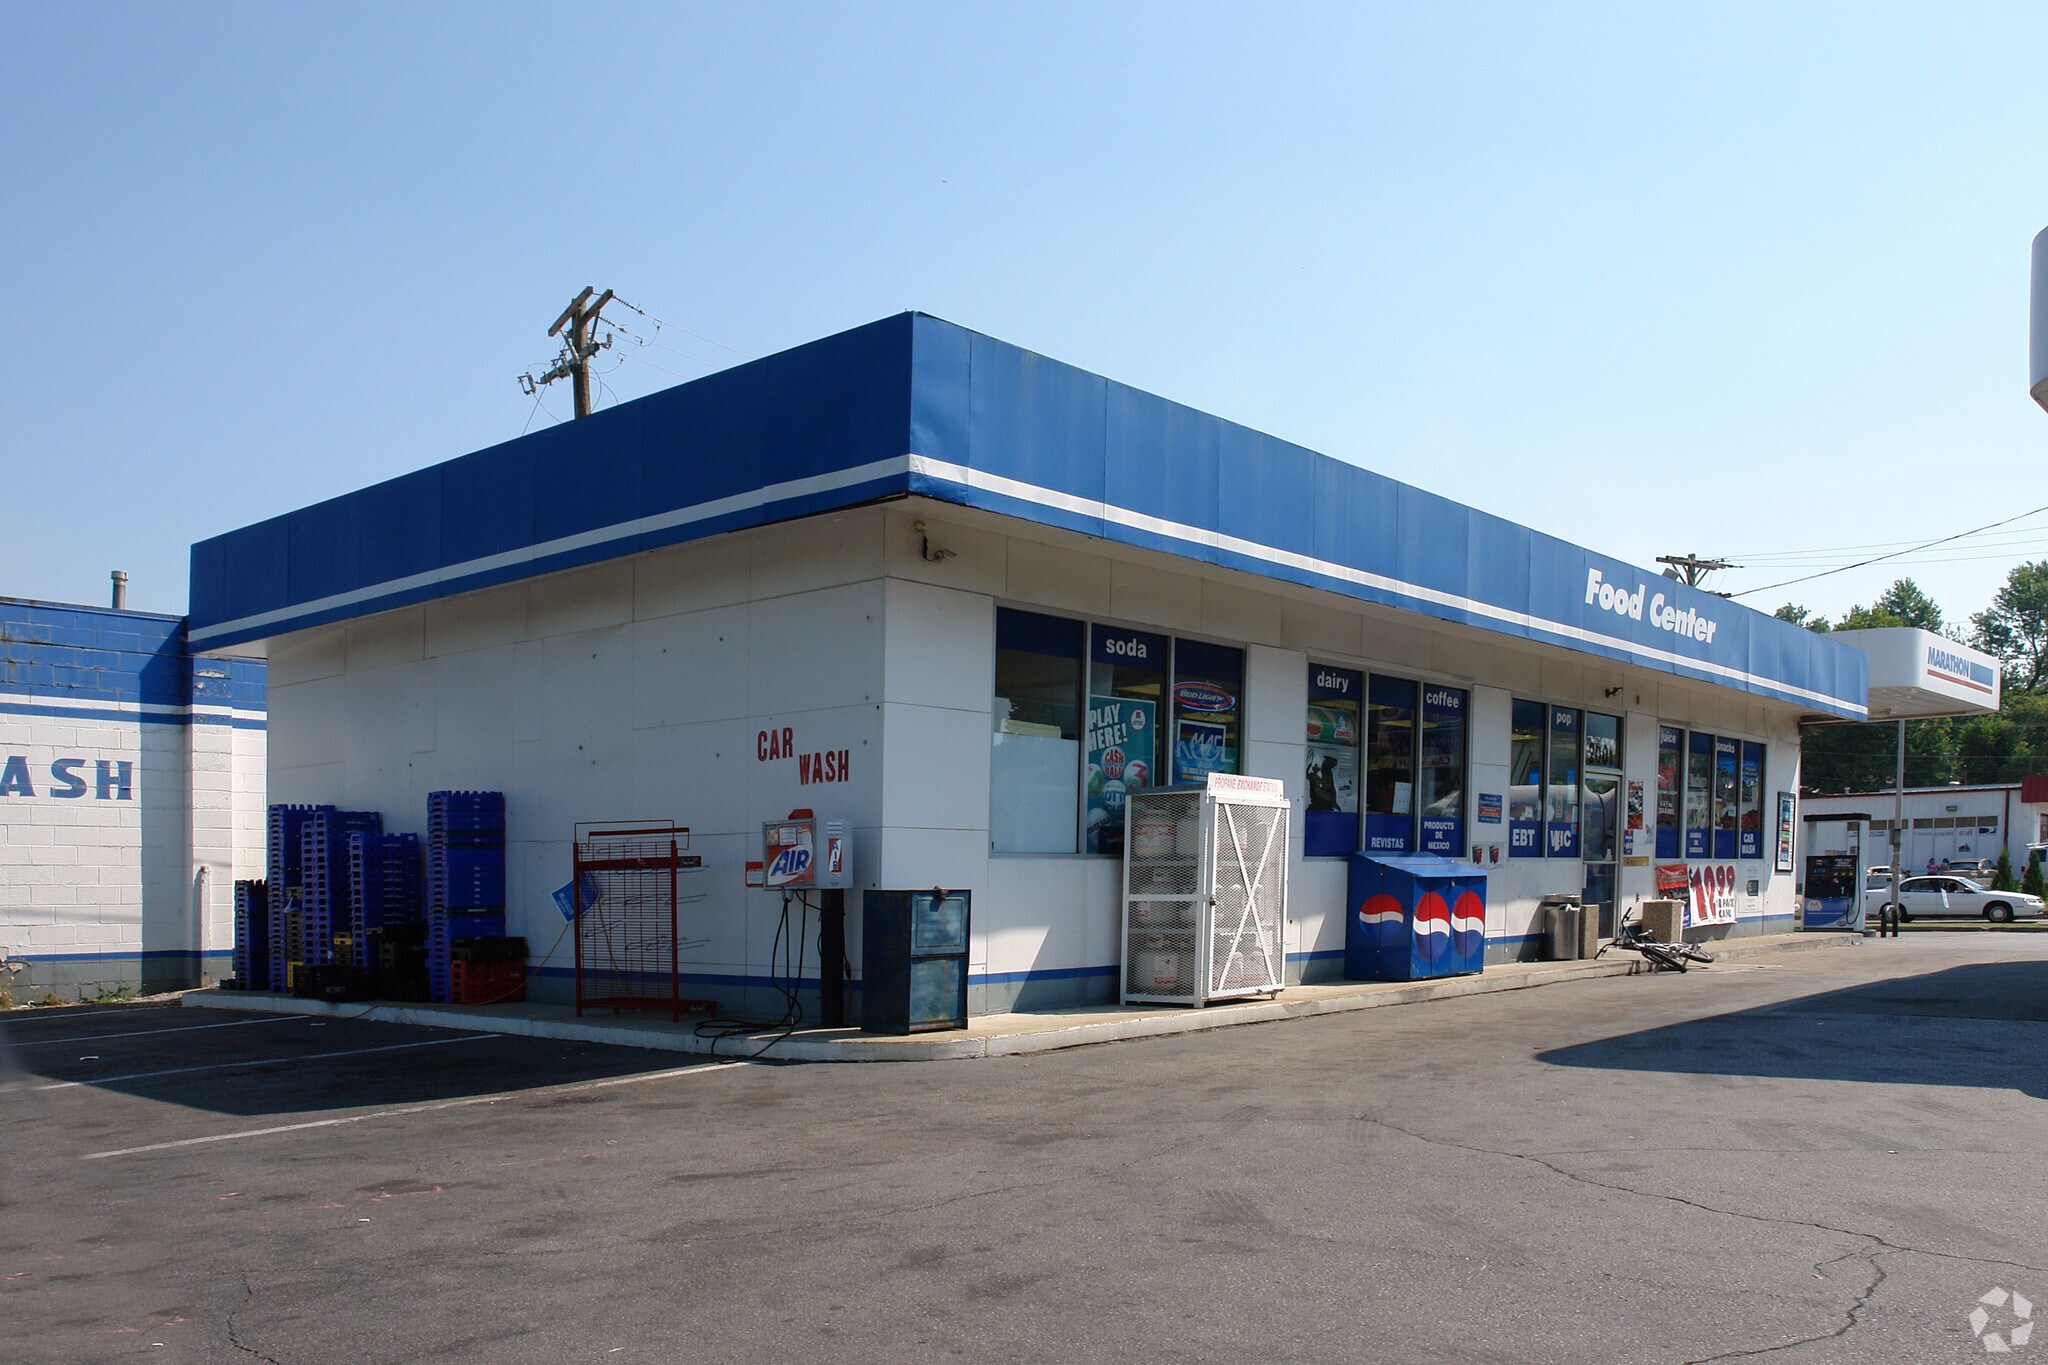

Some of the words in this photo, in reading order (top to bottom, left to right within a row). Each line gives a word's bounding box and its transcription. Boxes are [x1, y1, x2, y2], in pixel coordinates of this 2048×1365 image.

[1585, 568, 1646, 621] Food
[1650, 592, 1717, 644] Center
[1105, 638, 1147, 659] soda
[1927, 646, 1970, 678] MARATHON
[1317, 671, 1349, 693] dairy
[1180, 689, 1198, 699] BUD
[1426, 691, 1460, 708] coffee
[1089, 703, 1121, 732] PLAY
[1556, 712, 1572, 727] pop
[757, 727, 794, 762] CAR
[1088, 723, 1129, 753] HERE!
[1660, 730, 1677, 744] juice
[1716, 740, 1736, 754] snacks
[1104, 749, 1124, 764] CASH
[799, 750, 849, 785] WASH
[0, 755, 134, 800] ASH
[1214, 776, 1237, 790] PROPANE
[1237, 778, 1262, 792] EXCHANGE
[1423, 821, 1455, 831] PRODUCTS
[1371, 836, 1404, 849] REVISTAS
[1435, 831, 1444, 840] DE
[1512, 828, 1535, 847] EBT
[1743, 833, 1754, 844] CAR
[1428, 840, 1450, 850] MEXICO
[1742, 844, 1756, 855] WASH
[770, 850, 810, 877] AIR
[831, 841, 839, 871] AIR
[1840, 886, 1845, 895] 1
